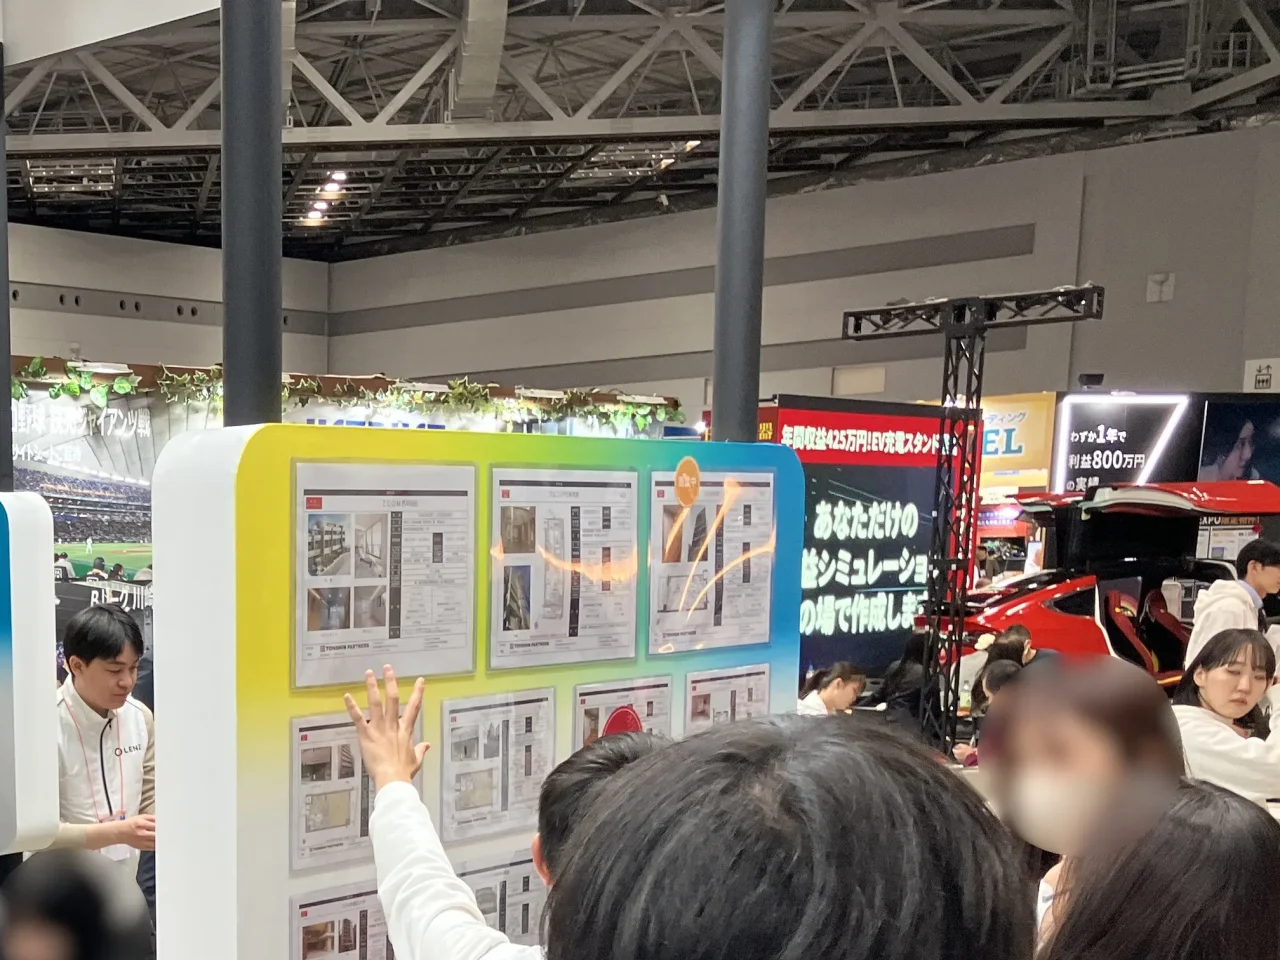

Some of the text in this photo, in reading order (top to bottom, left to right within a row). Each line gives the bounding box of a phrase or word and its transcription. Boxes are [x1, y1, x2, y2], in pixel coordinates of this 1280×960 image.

[1070, 424, 1127, 444] わずか1年で
[1068, 449, 1146, 470] 利益800万円
[813, 499, 919, 541] あなただけの
